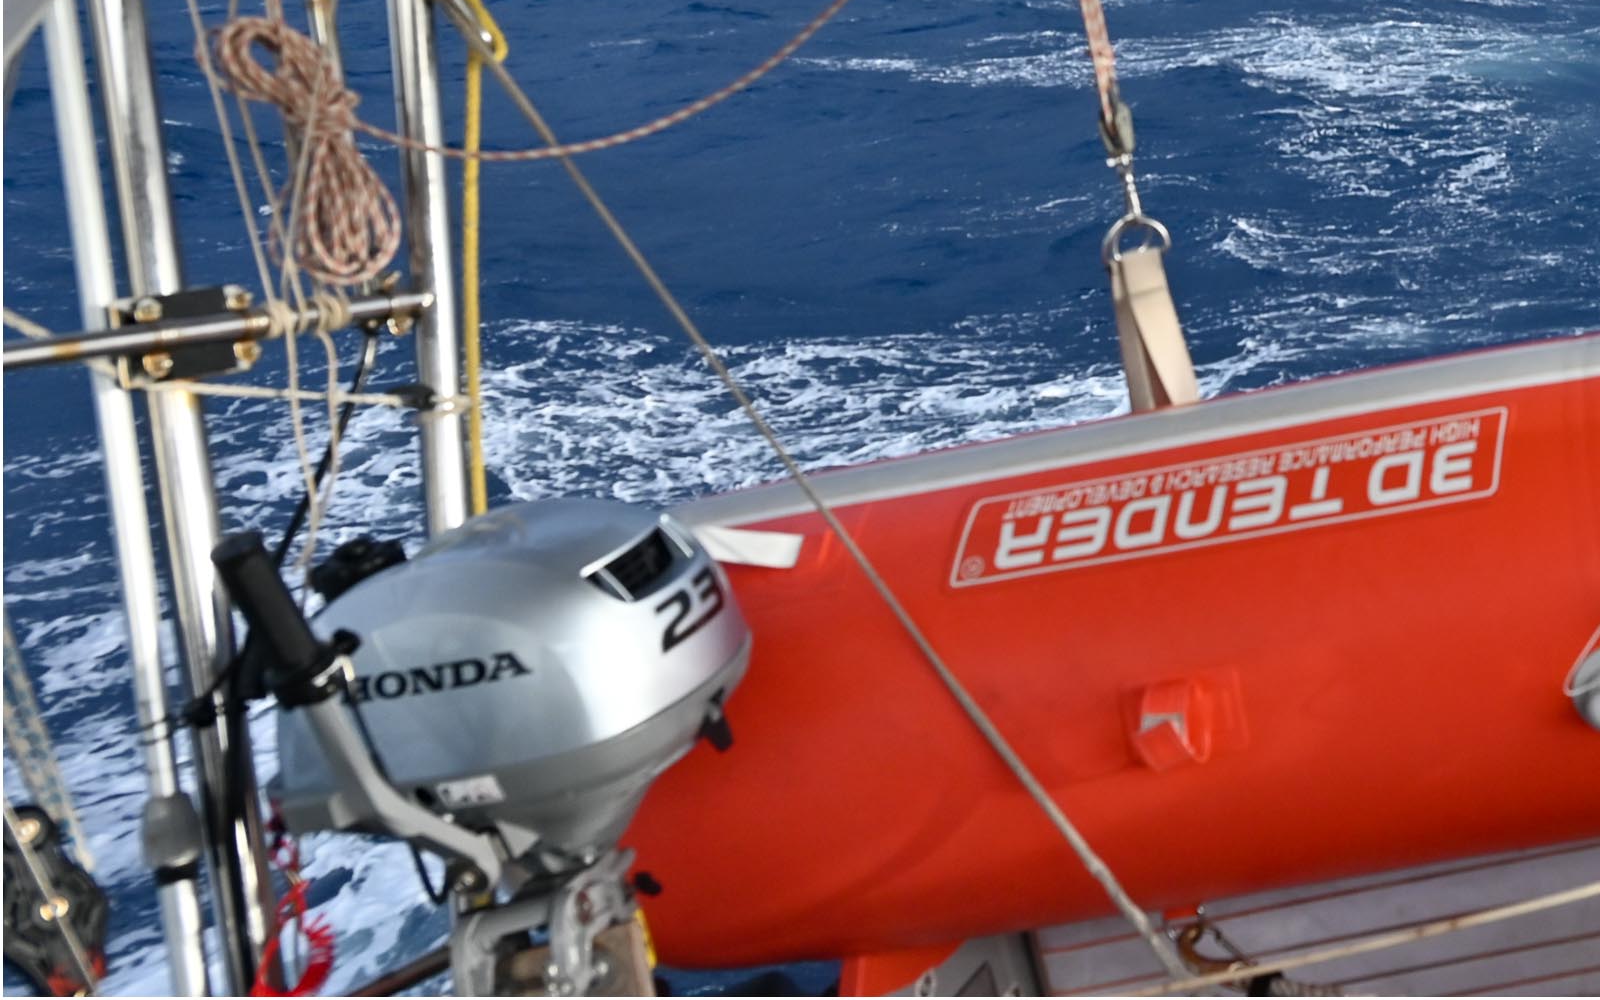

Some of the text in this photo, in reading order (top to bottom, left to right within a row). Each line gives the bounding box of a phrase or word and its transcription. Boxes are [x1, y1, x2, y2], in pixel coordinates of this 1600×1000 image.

[1278, 427, 1427, 474] PERFORMANCE
[1429, 417, 1481, 446] HIGH
[1164, 454, 1276, 493] RESEARCH
[1367, 440, 1478, 506] 3D
[993, 466, 1343, 570] TENDER
[1002, 475, 1148, 521] DEVELOPMENT
